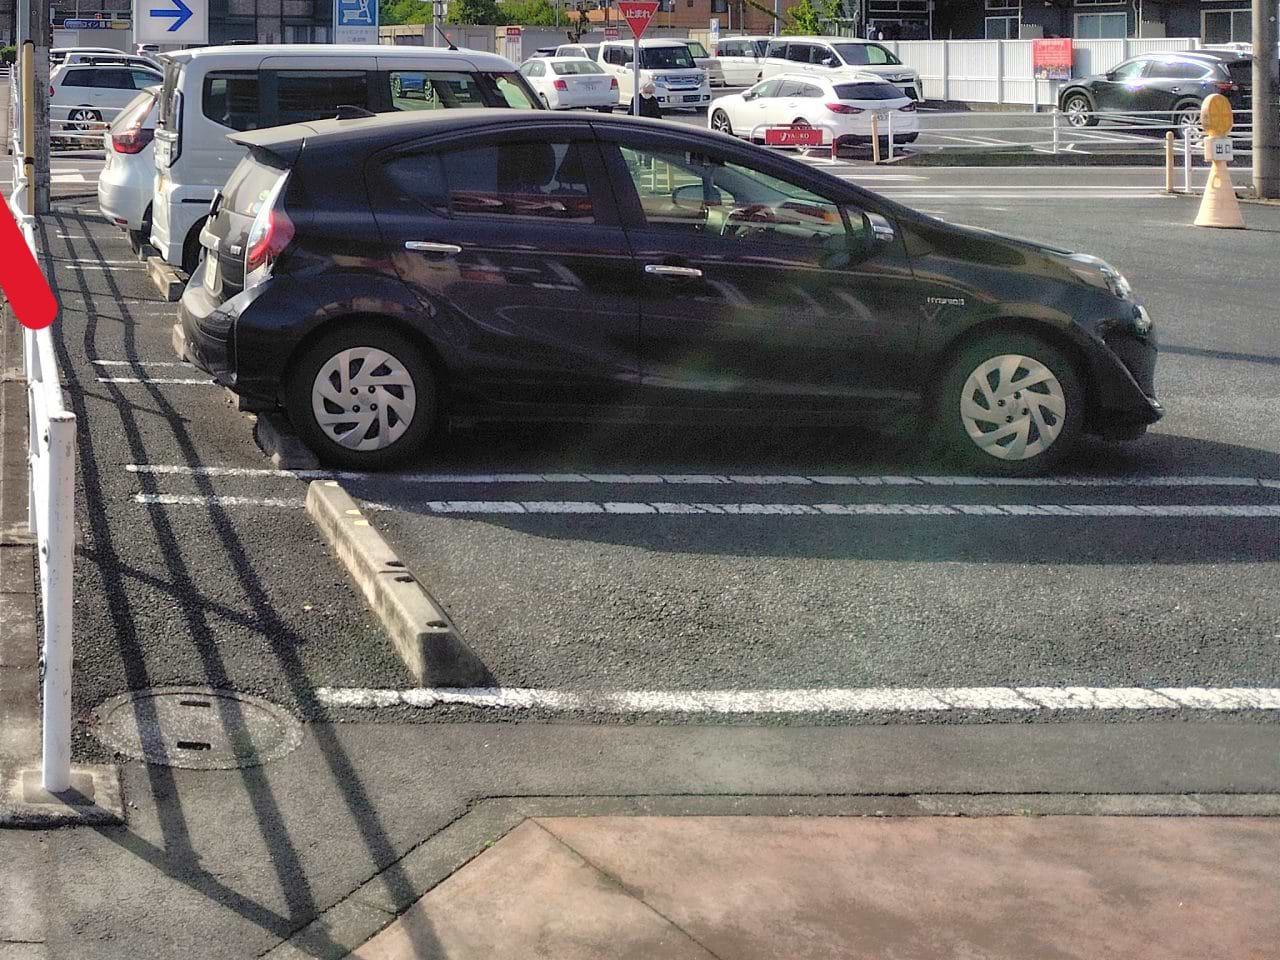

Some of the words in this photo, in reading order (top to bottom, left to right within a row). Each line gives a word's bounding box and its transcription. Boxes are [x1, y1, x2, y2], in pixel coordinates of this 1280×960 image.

[626, 9, 651, 18] 止まれ
[1216, 144, 1231, 154] 出口
